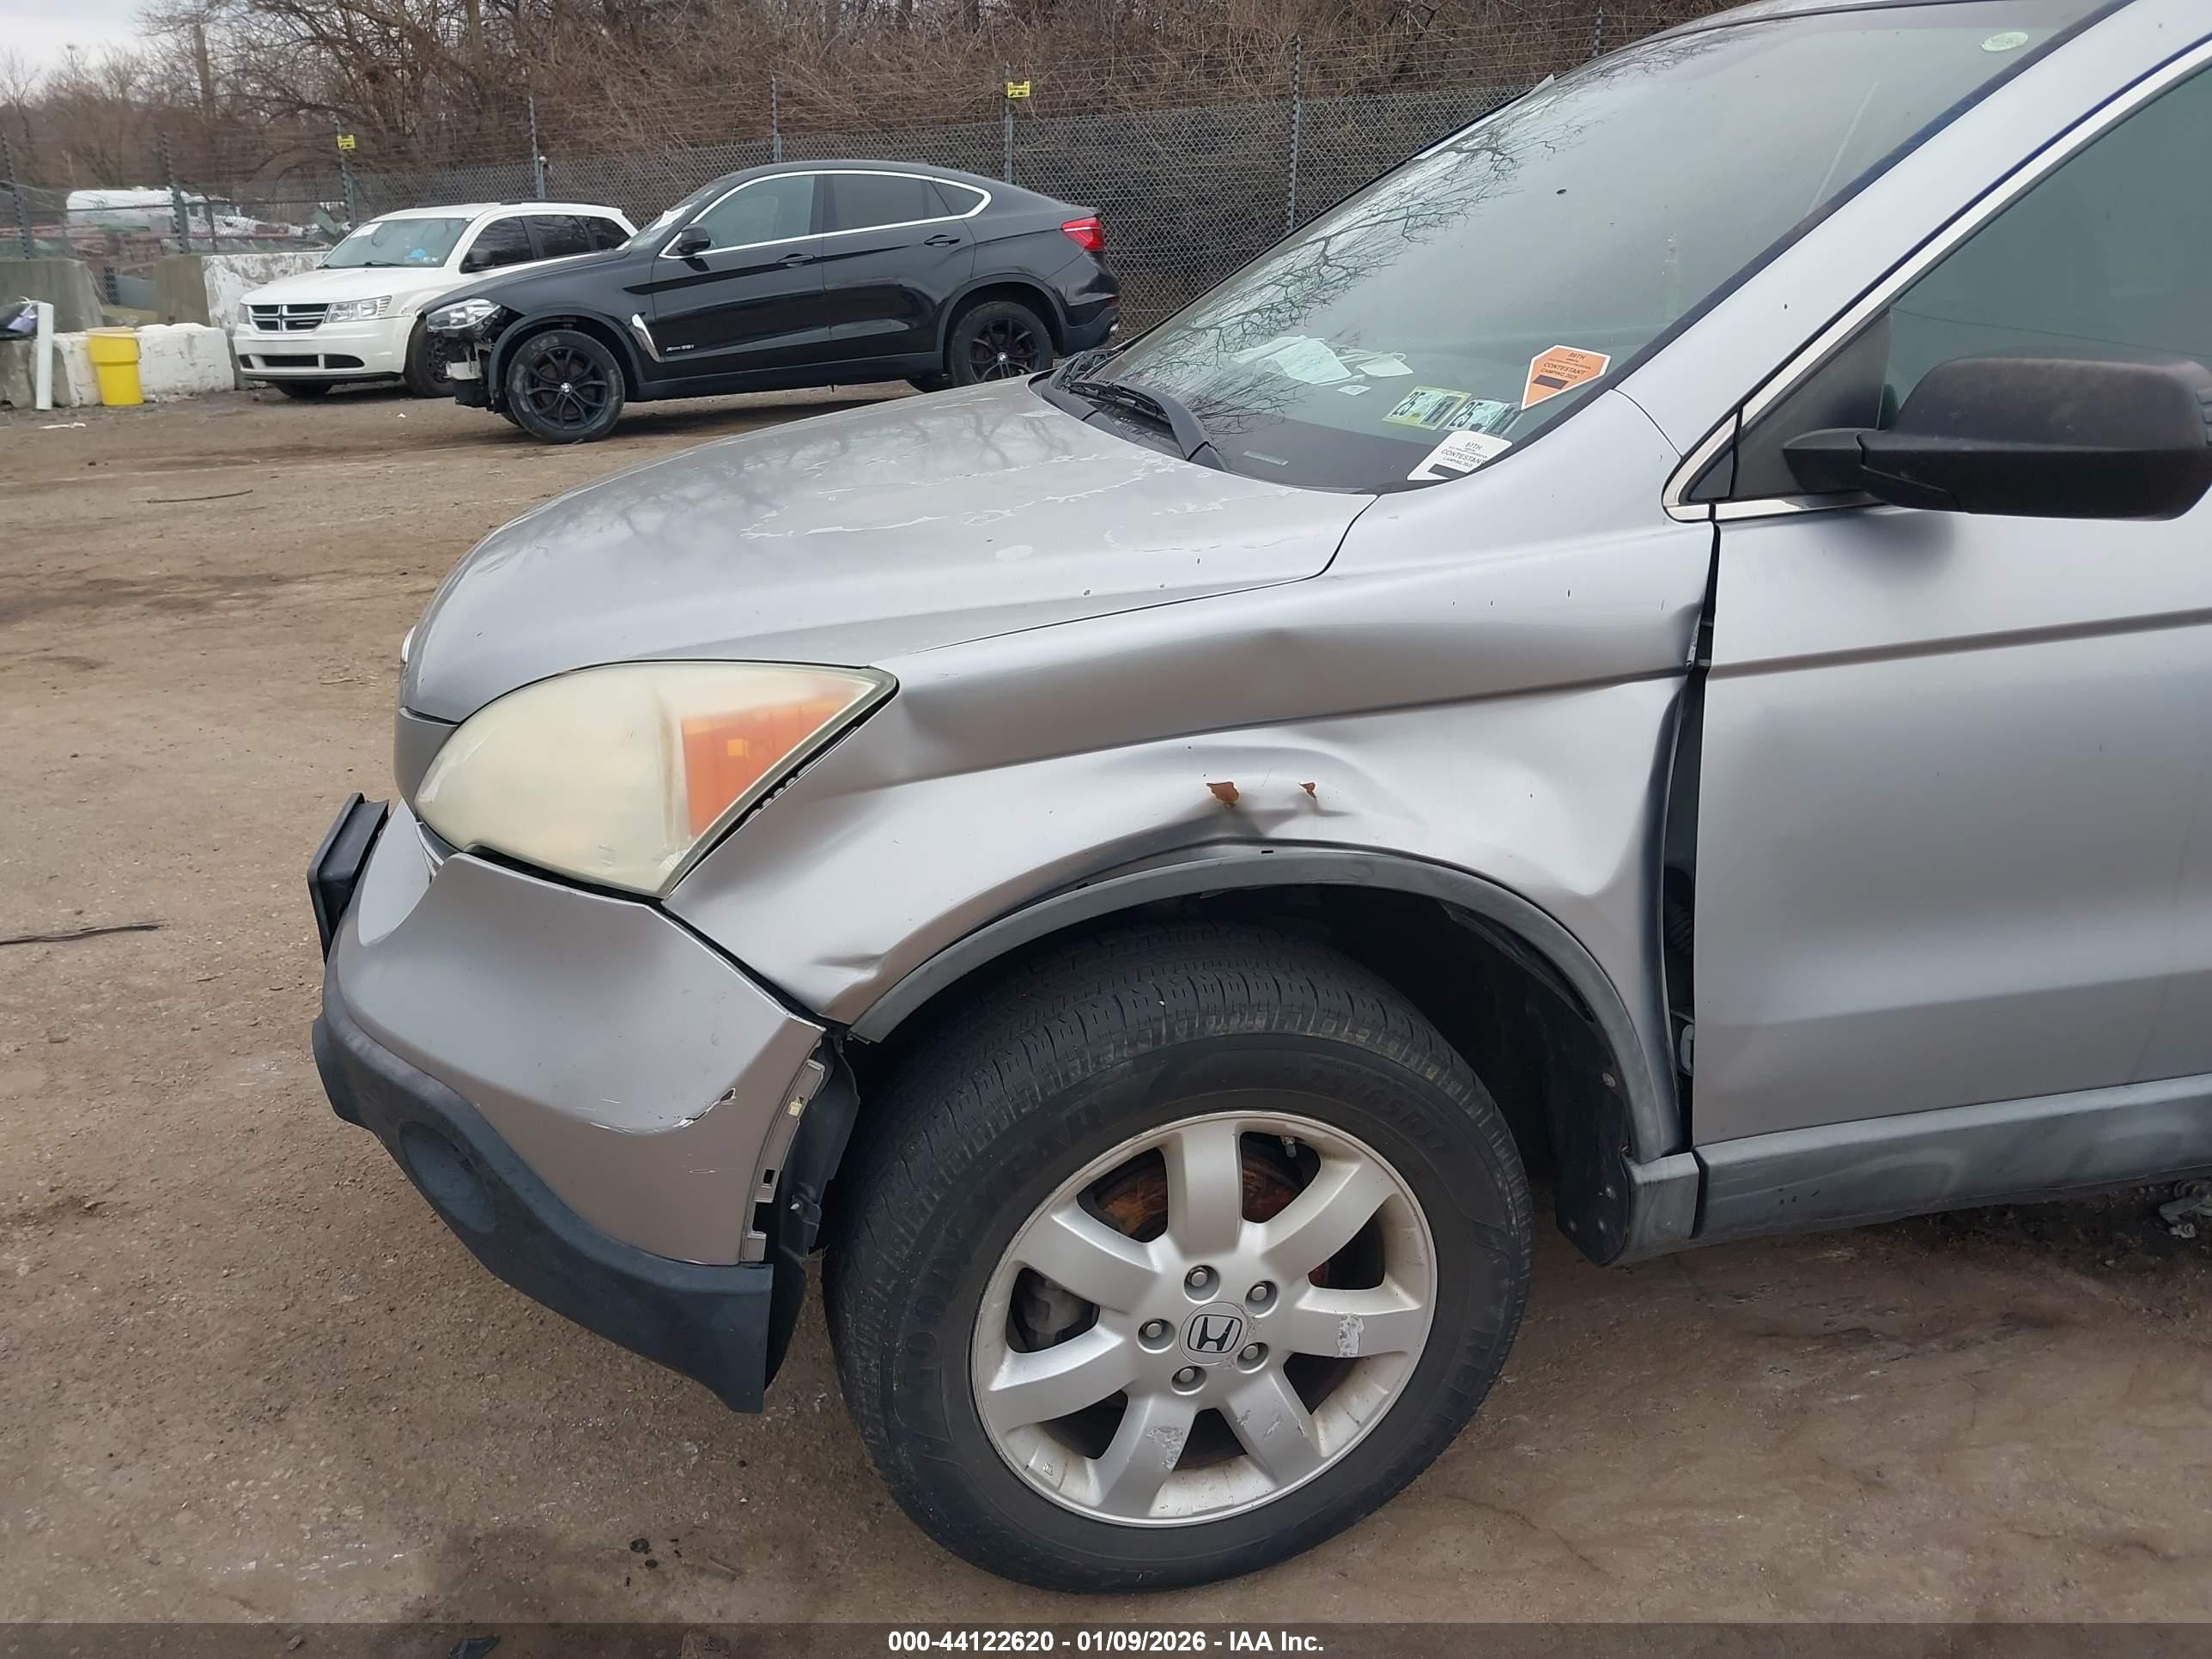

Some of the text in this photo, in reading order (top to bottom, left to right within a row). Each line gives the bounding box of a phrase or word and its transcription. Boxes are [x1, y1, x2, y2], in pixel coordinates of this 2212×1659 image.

[1540, 368, 1565, 378] CAMPING
[1544, 362, 1587, 375] CONTESTANT
[1391, 391, 1426, 416] 25
[1448, 401, 1485, 428] 25
[1441, 449, 1486, 464] CONTESTANT
[1443, 456, 1463, 465] CAMPING
